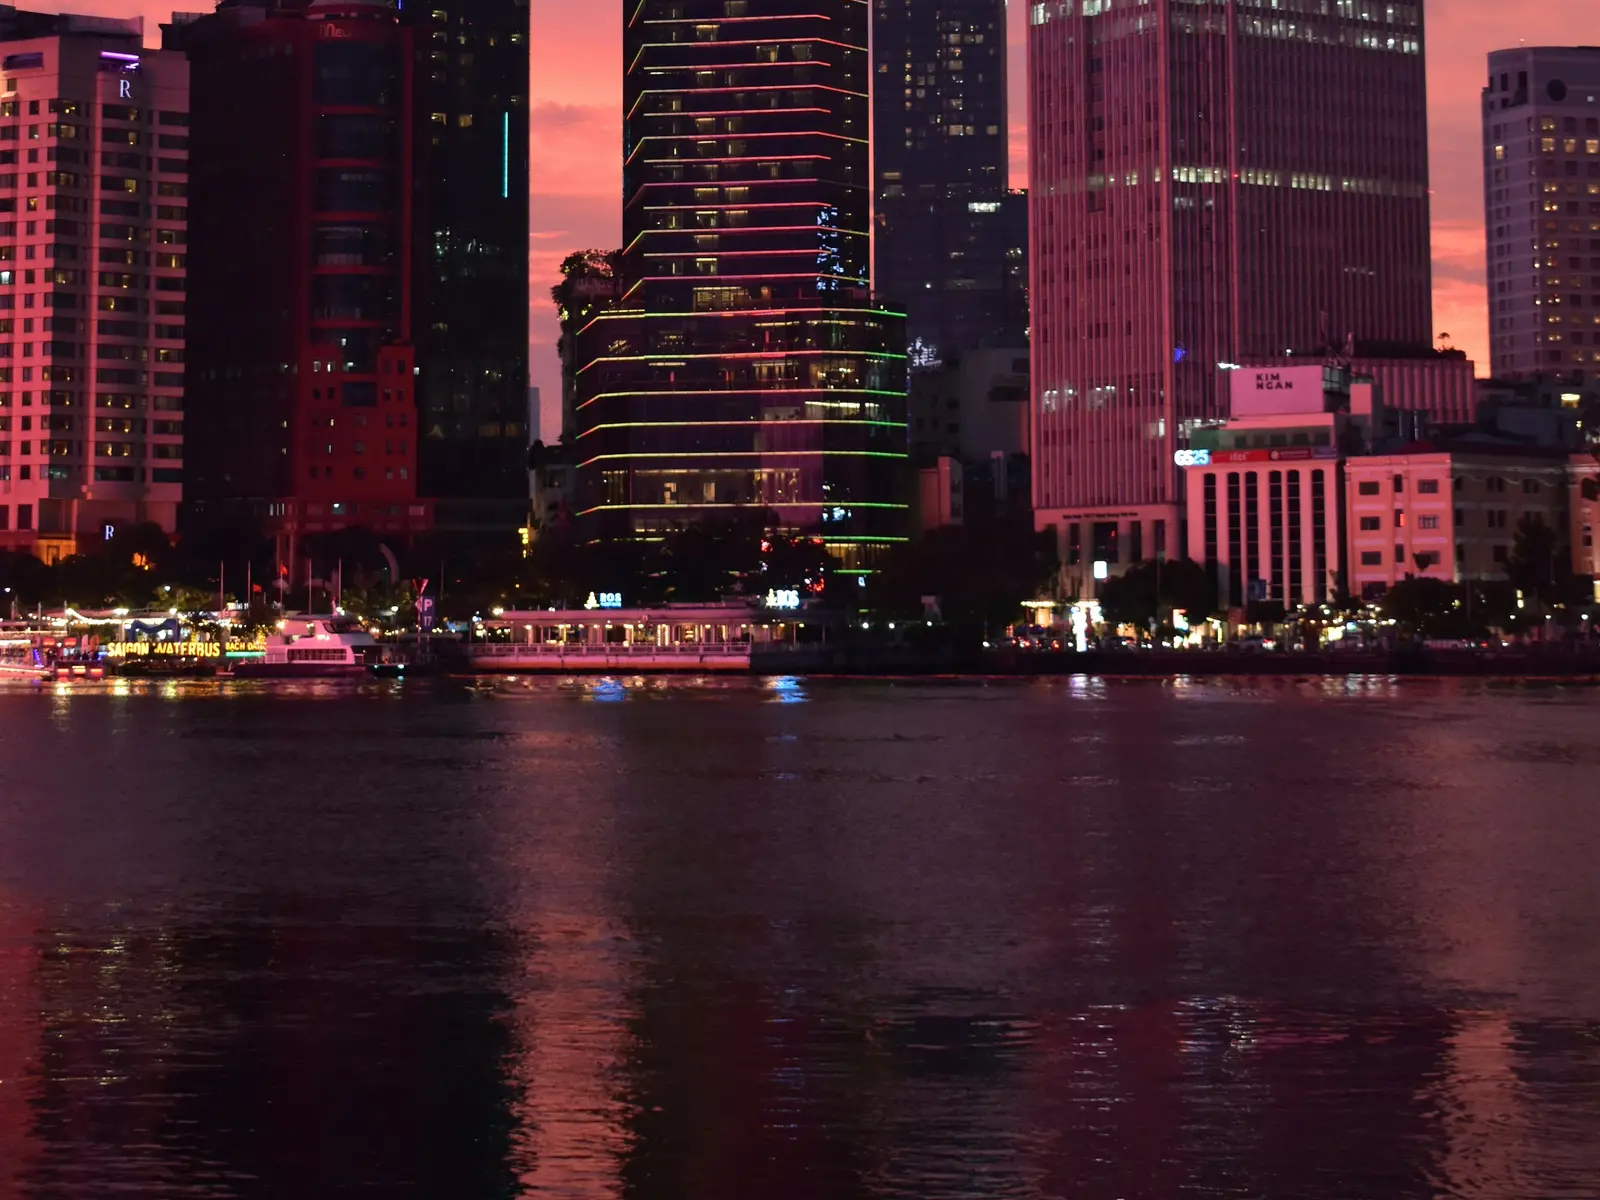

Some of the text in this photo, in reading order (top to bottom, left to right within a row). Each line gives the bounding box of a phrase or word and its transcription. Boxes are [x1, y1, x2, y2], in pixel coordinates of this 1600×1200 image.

[119, 79, 132, 99] R
[1256, 373, 1280, 381] KIM
[1256, 382, 1293, 390] NGAN
[1174, 449, 1210, 466] GS25
[105, 524, 115, 541] R
[424, 598, 433, 612] P
[424, 615, 432, 627] 17
[107, 642, 149, 657] SAIGON
